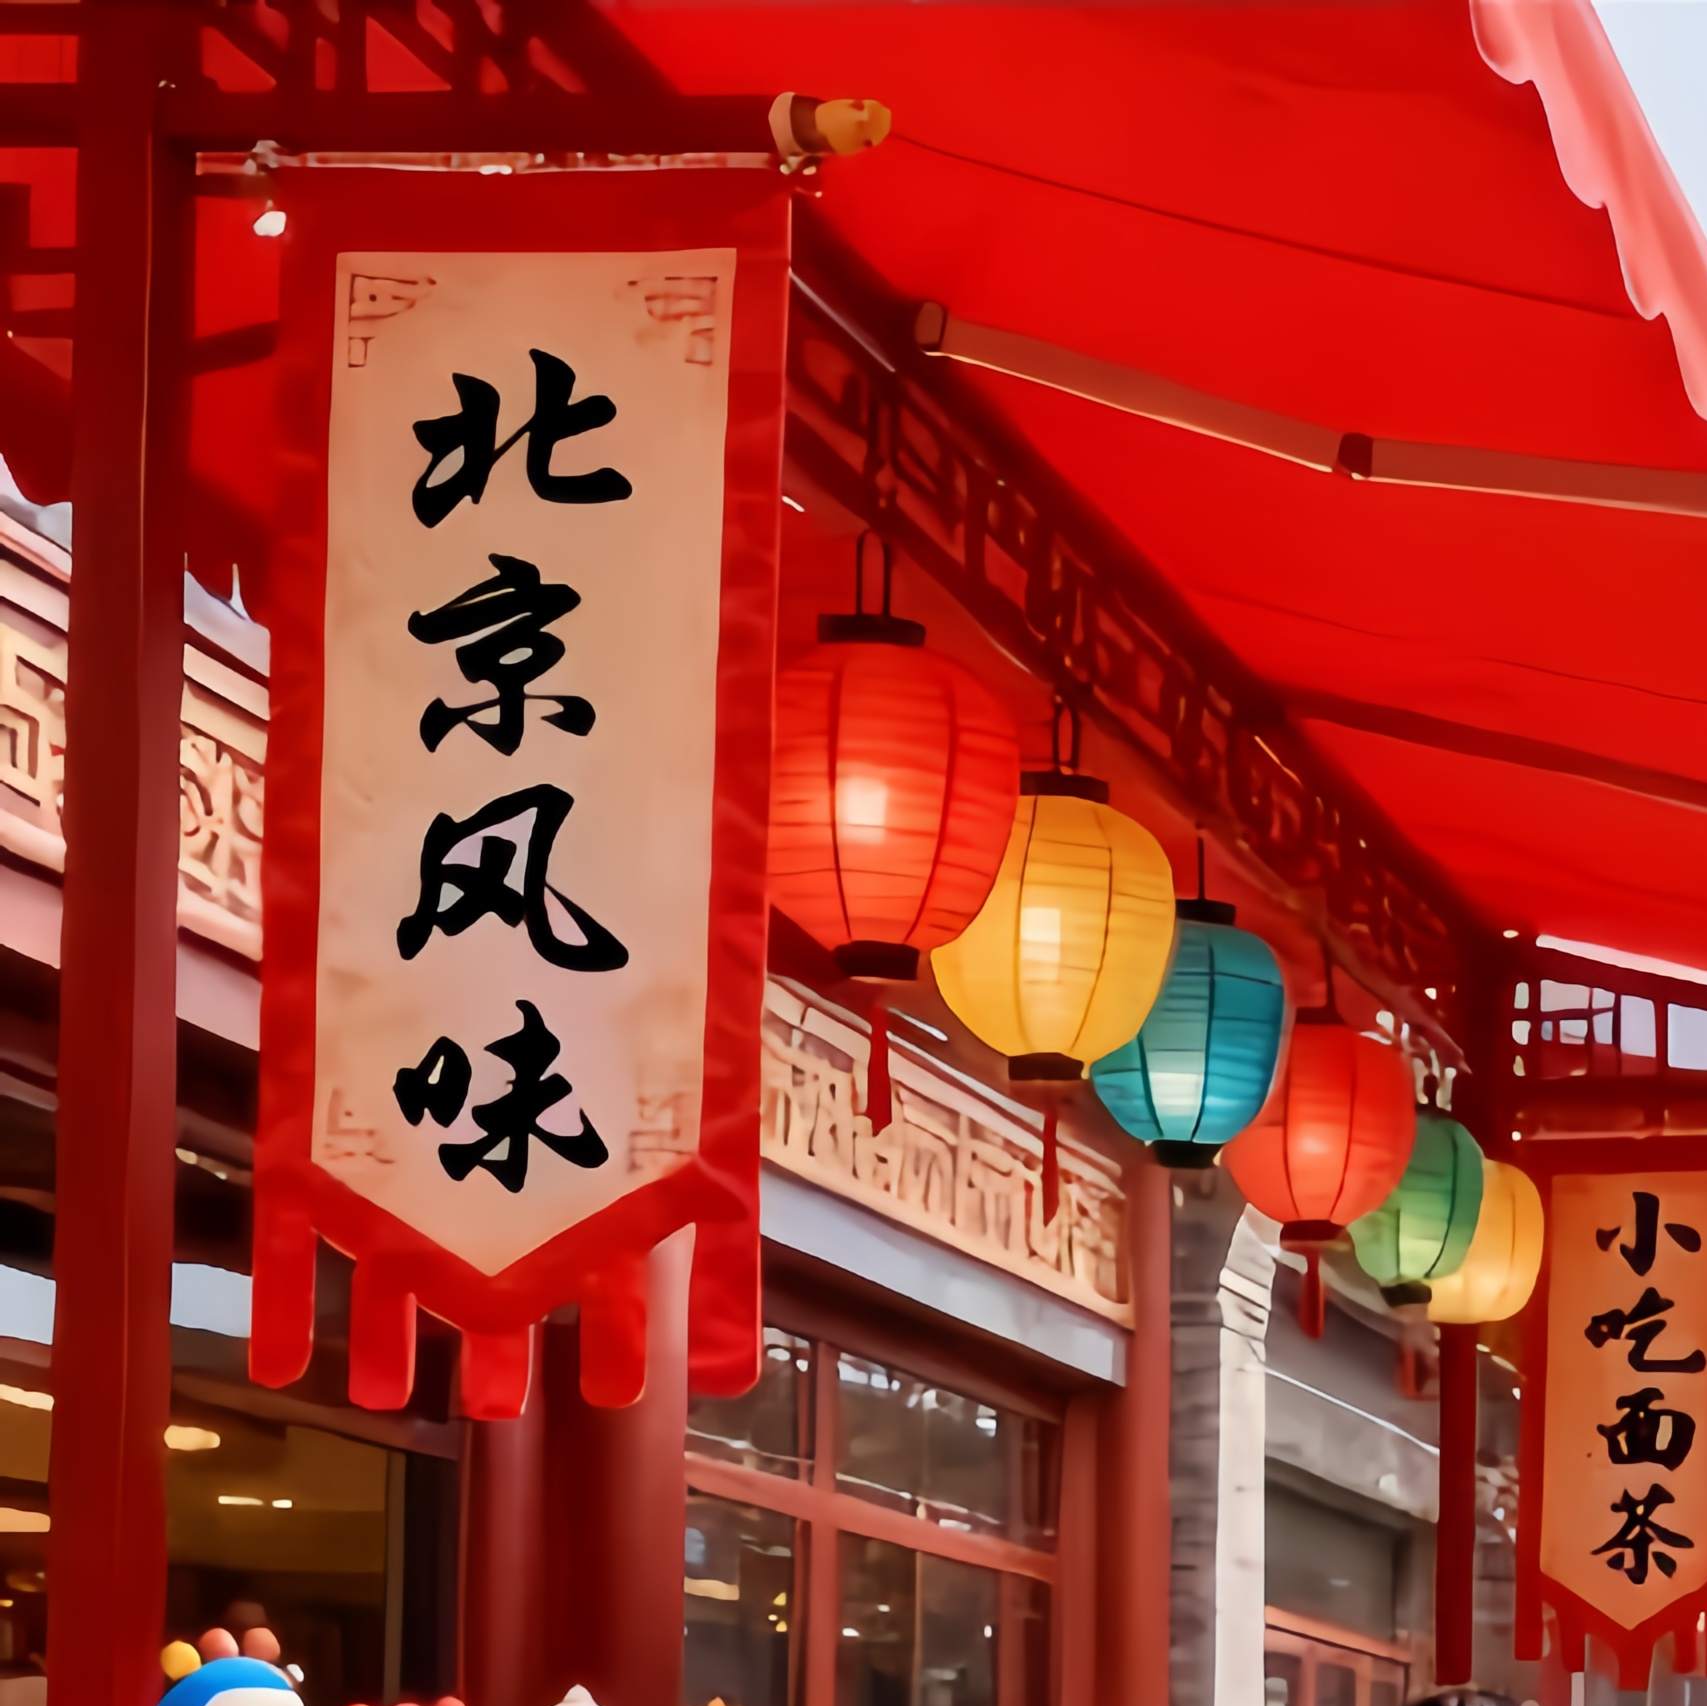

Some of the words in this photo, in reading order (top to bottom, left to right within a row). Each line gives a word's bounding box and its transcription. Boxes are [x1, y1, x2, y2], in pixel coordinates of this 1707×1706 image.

[392, 348, 633, 1194] 北京风味
[1584, 1191, 1706, 1585] 小吃面茶
